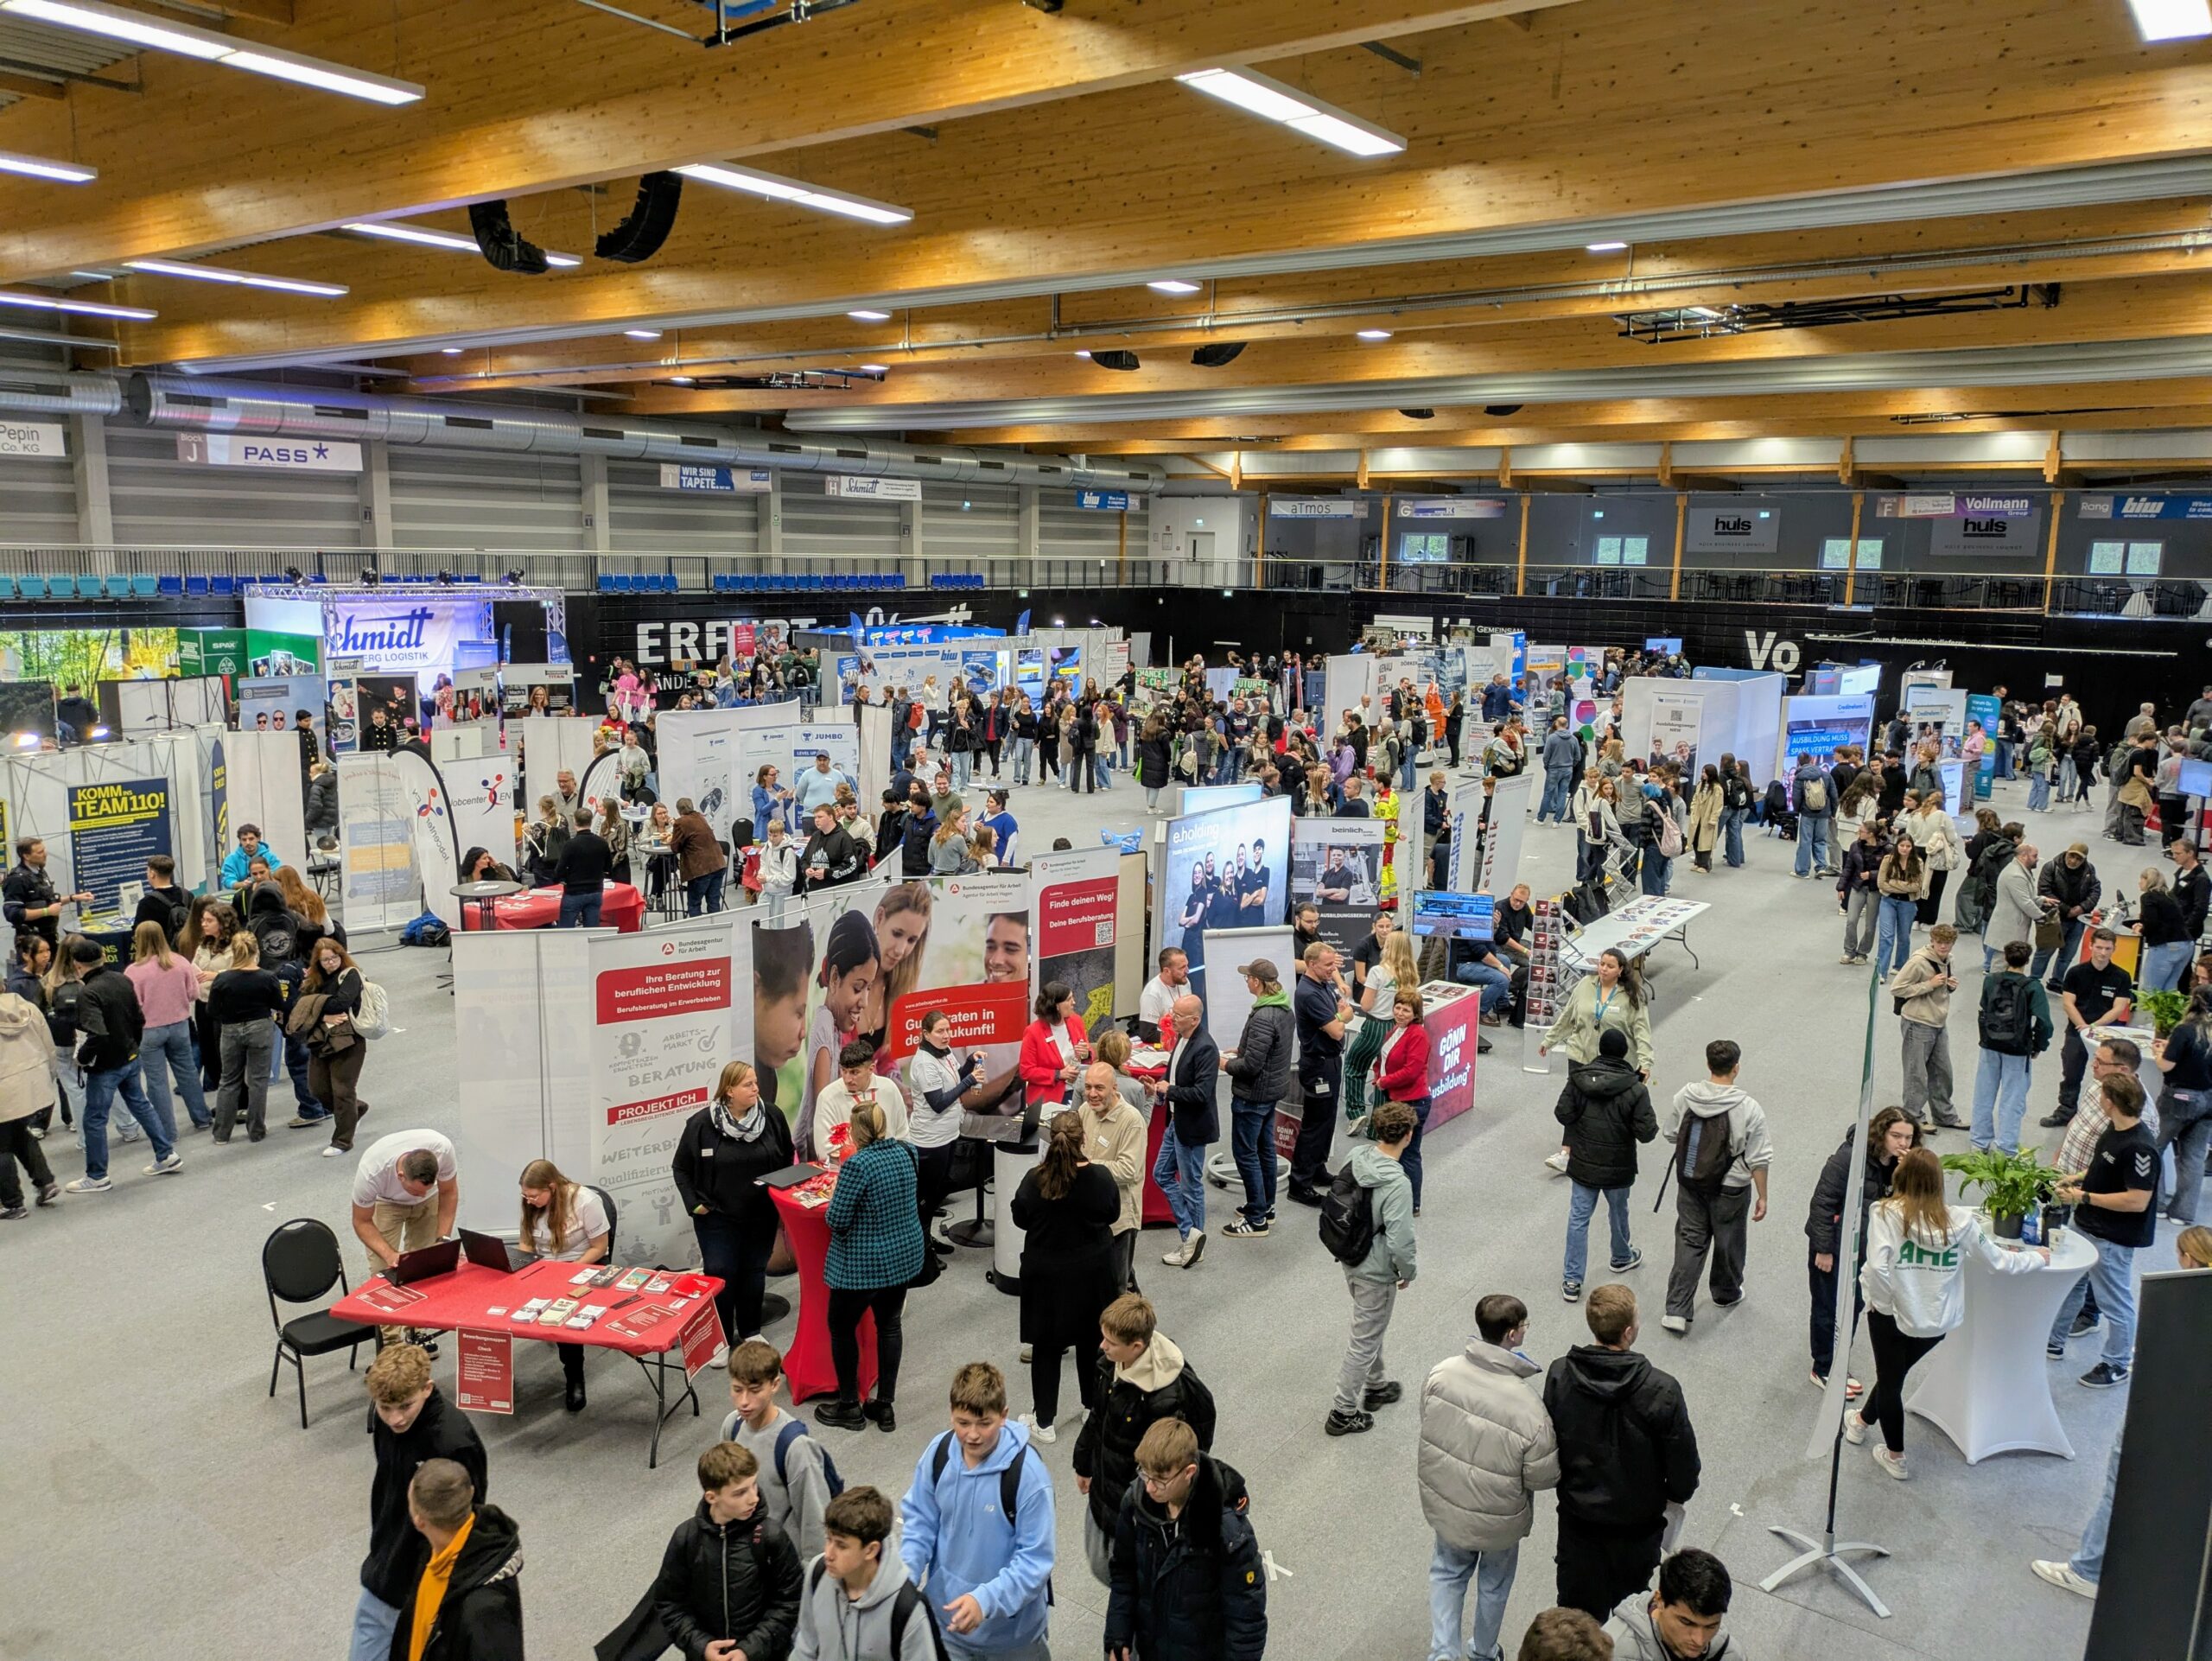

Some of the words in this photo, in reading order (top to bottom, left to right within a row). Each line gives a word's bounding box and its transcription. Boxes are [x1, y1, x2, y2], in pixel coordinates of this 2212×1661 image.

[22, 443, 40, 453] KG
[188, 445, 198, 462] J
[244, 446, 308, 463] PASS
[682, 467, 697, 476] WIR
[699, 468, 716, 477] SIND
[846, 477, 880, 493] Schmidt
[1400, 505, 1412, 516] G
[1884, 503, 1893, 517] F
[1966, 498, 2029, 510] Vollmann
[2081, 502, 2109, 512] Rang
[2121, 497, 2164, 513] biw
[1714, 518, 1752, 531] huls
[1963, 519, 2007, 532] huls
[364, 653, 381, 663] ERG
[385, 652, 429, 662] LOGISTIK
[940, 649, 958, 661] biw
[1792, 735, 1831, 744] AUSBILDUNG
[77, 785, 123, 801] KOMM
[499, 792, 512, 801] EN
[73, 797, 129, 818] TEAM
[130, 792, 166, 811] 110!
[1173, 823, 1220, 844] e.holding
[1484, 819, 1499, 888] echnik
[1049, 901, 1070, 910] Finde
[1071, 896, 1096, 906] deinen
[1096, 892, 1114, 902] Weg!
[1068, 913, 1114, 926] Berufsberatung
[102, 945, 118, 953] NS
[678, 937, 723, 947] Bundesagentur
[104, 954, 118, 963] 10!
[645, 974, 663, 984] Ihre
[665, 969, 705, 982] Beratung
[707, 967, 721, 976] zur
[614, 985, 665, 998] beruflichen
[668, 978, 721, 992] Entwicklung
[617, 1000, 668, 1014] Berufsberatung
[678, 995, 721, 1006] Erwerbsleben
[906, 1018, 923, 1031] Gu
[948, 1010, 978, 1023] raten
[982, 1008, 994, 1020] in
[905, 1034, 923, 1047] dei
[950, 1022, 995, 1039] ukunft!
[1440, 1023, 1467, 1057] GÖNN
[664, 1038, 693, 1051] MARKT
[1444, 1047, 1460, 1073] DIR
[628, 1057, 717, 1087] BERATUNG
[618, 1098, 674, 1120] PROJEKT
[677, 1092, 696, 1107] ICH
[620, 1111, 676, 1126] LEBENSBEGLEITENDE
[1896, 1239, 1960, 1267] AHE
[462, 1333, 506, 1343] Bewerbungsmappen
